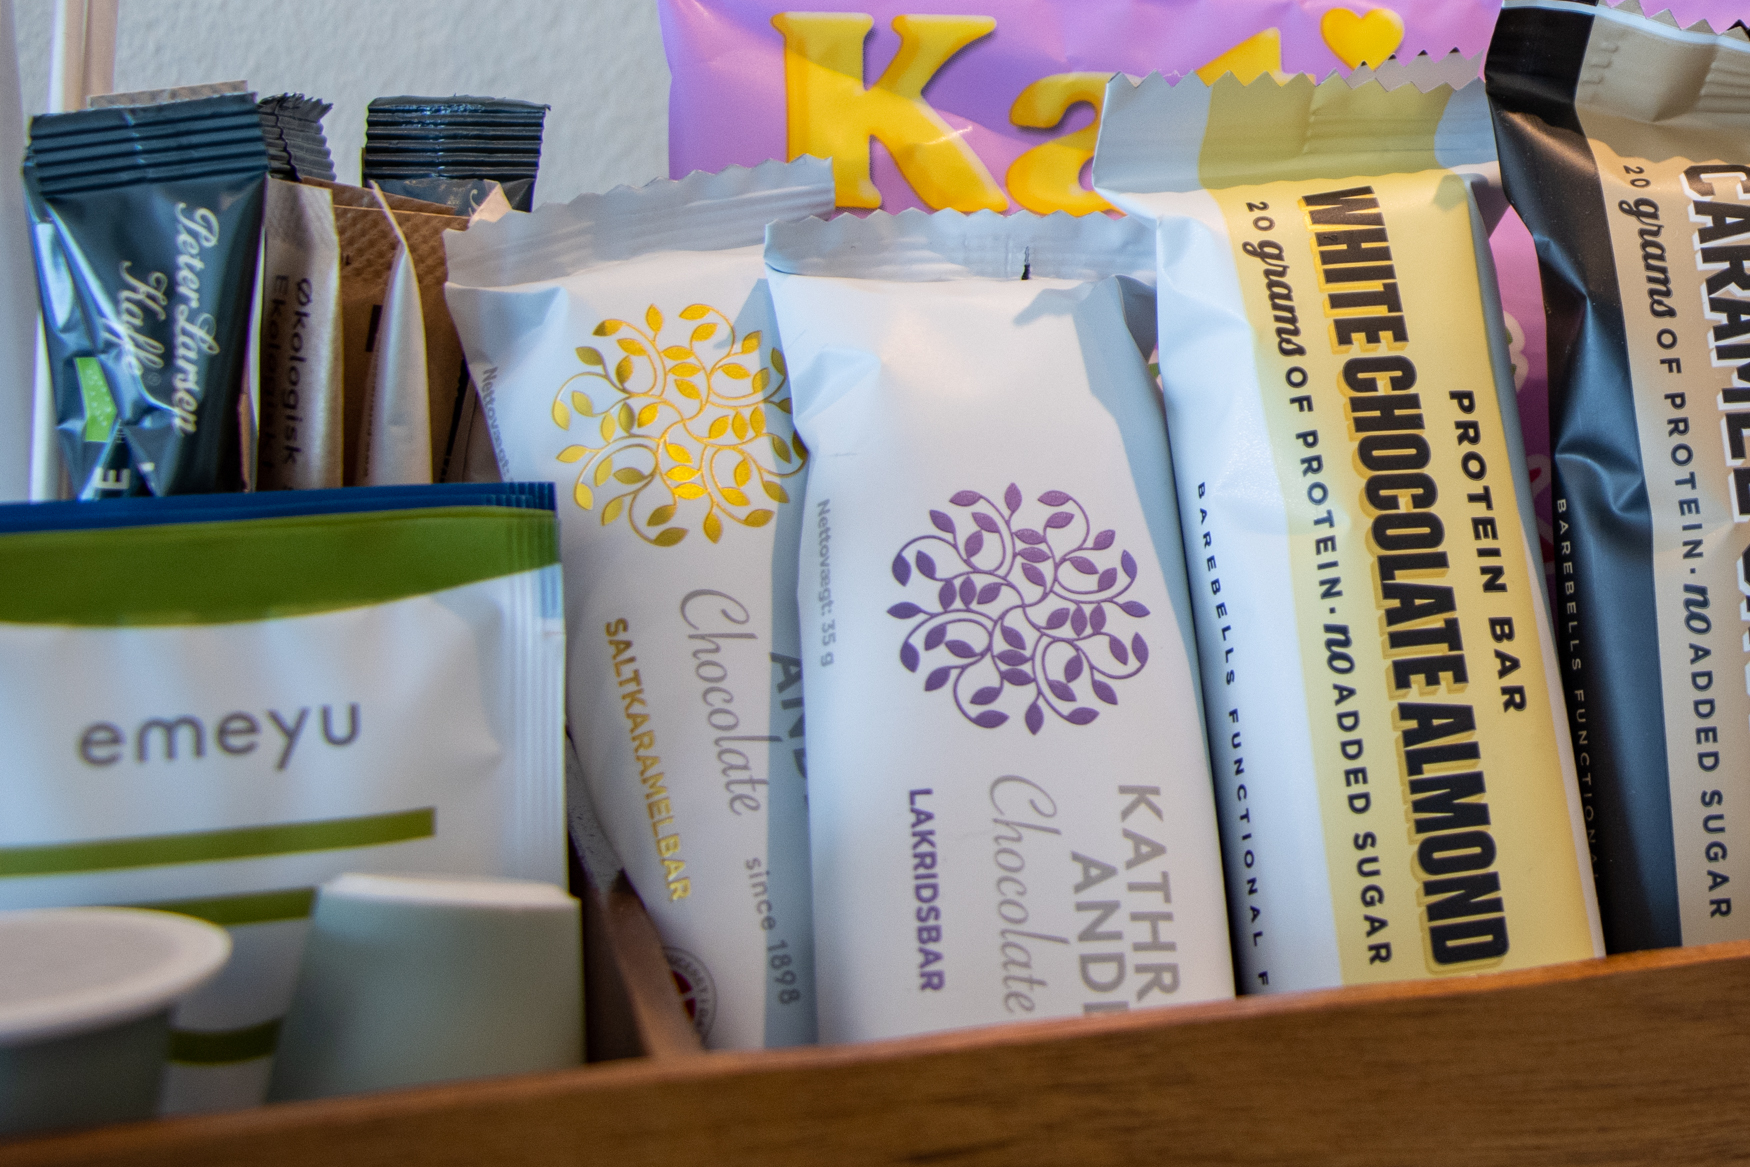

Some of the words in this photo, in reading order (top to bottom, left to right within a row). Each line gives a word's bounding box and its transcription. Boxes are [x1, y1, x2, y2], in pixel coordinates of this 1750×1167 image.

[1245, 200, 1276, 232] 20
[1621, 164, 1652, 190] 20
[100, 261, 169, 376] Kaffe
[175, 201, 220, 308] Peter
[1241, 237, 1308, 358] grams
[1300, 185, 1410, 354] WHITE
[1617, 196, 1678, 320] grams
[171, 304, 221, 437] Larsen
[284, 278, 312, 465] Økologisk
[1285, 364, 1314, 414] OF
[1655, 327, 1683, 376] OF
[1337, 355, 1469, 699] CHOCOLATE
[1448, 389, 1509, 594] PROTEIN
[1487, 615, 1528, 714] BAR
[1556, 497, 1583, 672] BAREBELLS
[820, 618, 837, 647] 35
[820, 651, 834, 668] g
[1323, 622, 1356, 676] no
[1682, 583, 1713, 635] no
[76, 701, 362, 771] emeyu
[604, 616, 693, 903] SALTKARAMELBAR
[679, 588, 783, 818] Chocolate
[1196, 480, 1236, 687] BAREBELLS
[1227, 707, 1265, 948] FUNCTIONAL
[1331, 683, 1373, 815] ADDED
[1688, 641, 1721, 773] ADDED
[907, 786, 947, 994] LAKRIDSBAR
[988, 774, 1071, 1015] Chocolate
[1352, 830, 1393, 966] SUGAR
[1393, 701, 1511, 973] ALMOND
[1699, 789, 1733, 920] SUGAR
[744, 855, 778, 933] since
[766, 937, 802, 1007] 1898
[1070, 849, 1130, 1015] AND
